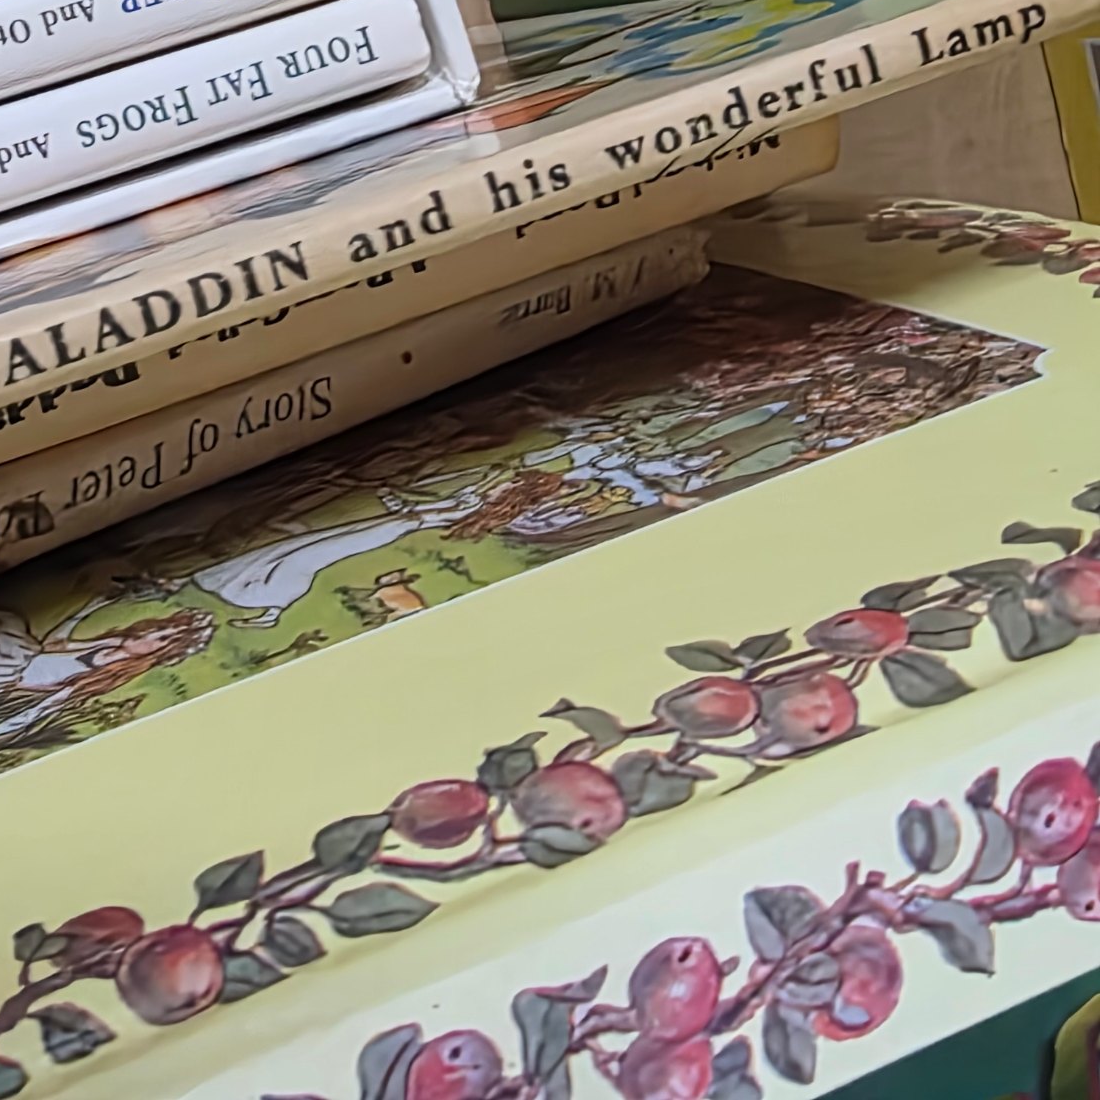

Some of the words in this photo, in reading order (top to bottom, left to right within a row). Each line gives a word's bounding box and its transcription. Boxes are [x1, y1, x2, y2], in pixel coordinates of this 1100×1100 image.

[206, 57, 274, 101] FAT
[277, 25, 379, 82] FOUR
[75, 86, 198, 149] FROGS
[4, 240, 309, 386] ALADDIN
[349, 190, 454, 263] and
[484, 158, 572, 214] his
[604, 44, 885, 172] wonderful
[910, 2, 1048, 68] Lamp
[180, 418, 220, 476] of
